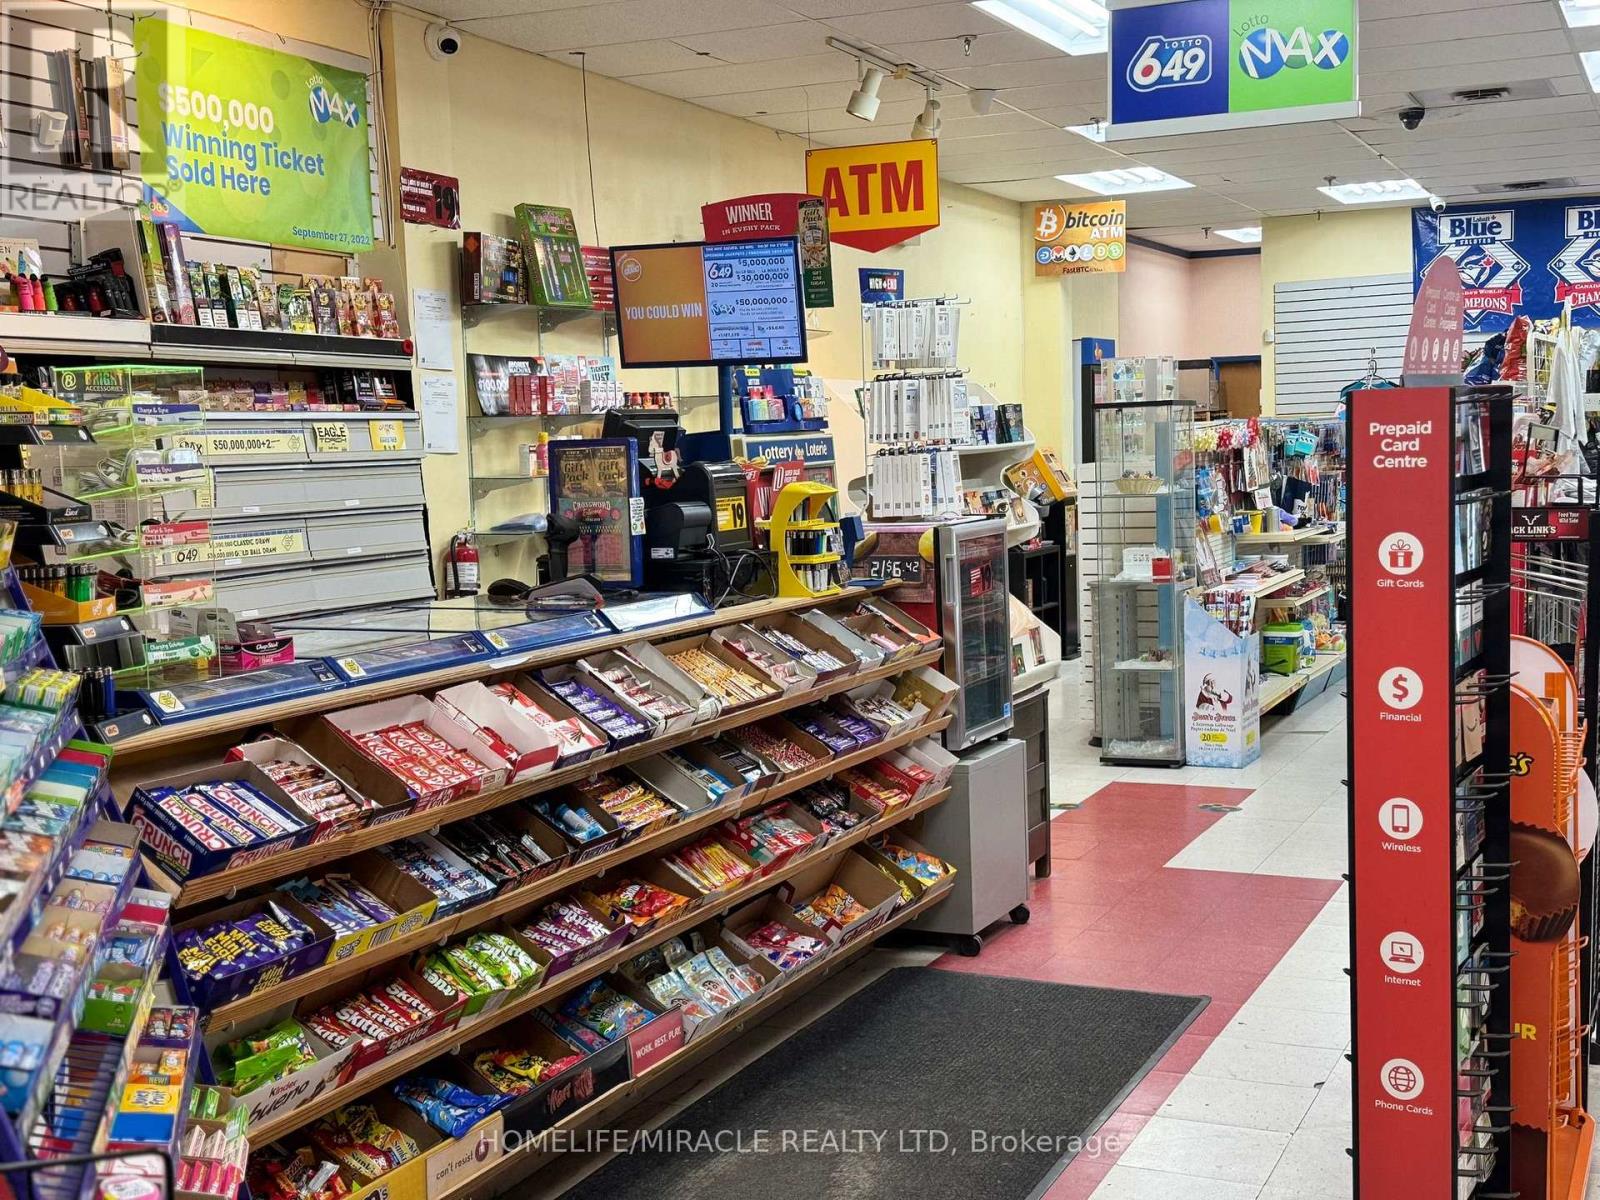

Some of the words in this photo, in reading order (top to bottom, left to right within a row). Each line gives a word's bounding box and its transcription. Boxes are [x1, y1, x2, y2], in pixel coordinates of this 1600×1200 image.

[1233, 13, 1269, 37] Lotto
[1165, 38, 1202, 49] LOTTO
[1240, 26, 1344, 79] MAX
[1133, 42, 1205, 86] 649
[304, 75, 324, 88] Lotto
[158, 86, 274, 134] $500,000
[310, 87, 360, 128] MAX
[161, 121, 257, 171] Winning
[261, 143, 325, 177] Ticket
[166, 155, 216, 186] Sold
[220, 167, 271, 196] Here
[821, 160, 925, 217] ATM
[725, 202, 774, 224] WINNER
[1065, 208, 1125, 228] bitcoin
[292, 225, 338, 241] September
[351, 234, 371, 246] 2022
[732, 226, 758, 234] EVERY
[1091, 226, 1123, 240] ATM
[1449, 217, 1503, 238] Blue
[625, 306, 642, 320] YOU
[647, 304, 679, 319] COULD
[680, 303, 702, 317] WIN
[1464, 297, 1508, 311] MPIONS
[317, 424, 346, 437] EAGLE
[1369, 420, 1432, 437] Prepaid
[759, 445, 793, 461] Lottery
[805, 440, 827, 456] Loterie
[1381, 438, 1420, 452] Card
[1373, 455, 1428, 468] Centre
[732, 502, 744, 528] 19
[1377, 578, 1394, 588] Gift
[1396, 578, 1424, 588] Cards
[1379, 712, 1422, 722] Financial
[186, 795, 252, 840] CRUNCH
[214, 788, 281, 834] CRUNCH
[162, 799, 227, 849] CRUNCH
[131, 812, 192, 868] CRUNCH
[1382, 842, 1421, 853] Wireless
[229, 838, 294, 869] CRUNCH
[1384, 974, 1421, 987] Internet
[654, 1036, 667, 1049] REST.
[268, 1078, 299, 1099] Kinder
[248, 1080, 310, 1125] bueno
[1375, 1099, 1404, 1112] Phone
[1406, 1103, 1433, 1115] Cards
[435, 1161, 454, 1180] can't
[455, 1152, 474, 1169] resist
